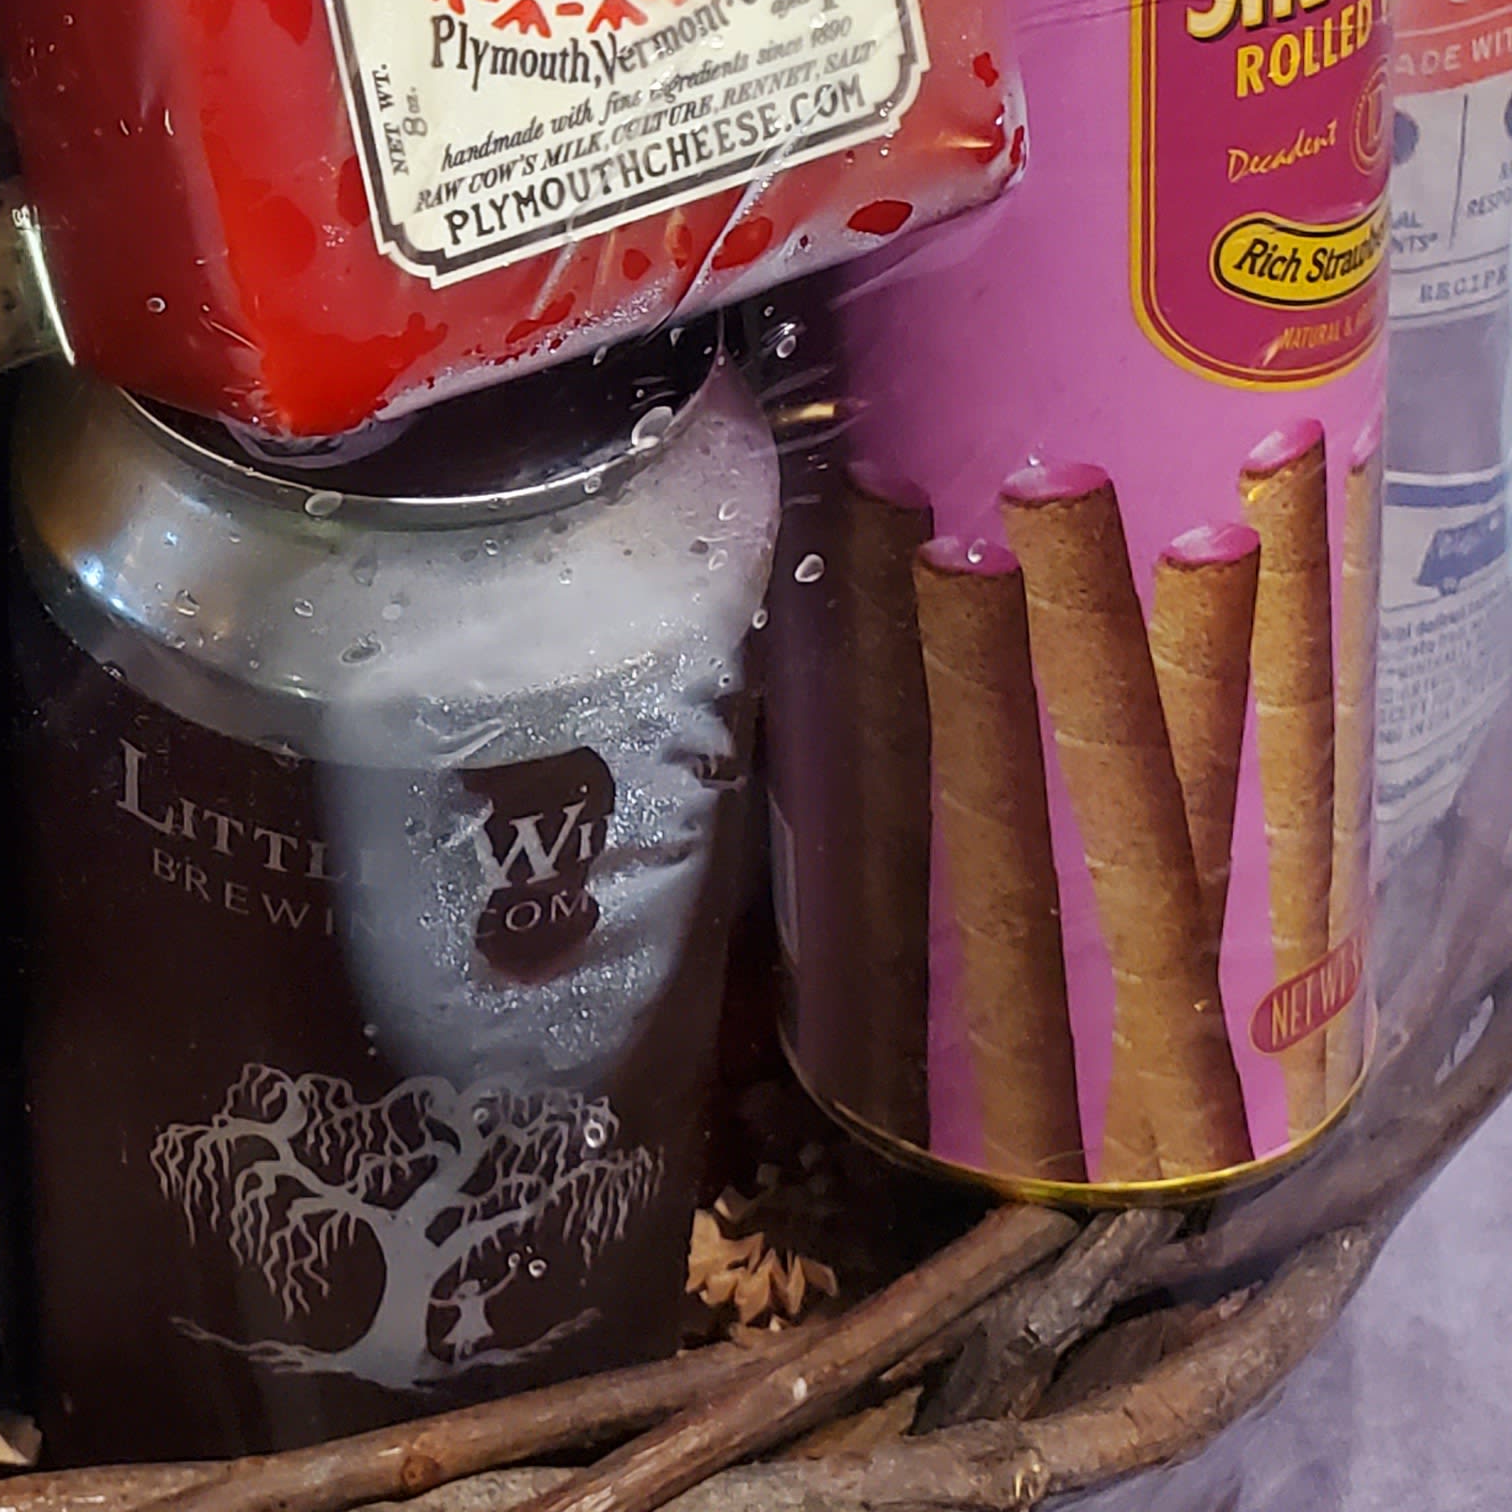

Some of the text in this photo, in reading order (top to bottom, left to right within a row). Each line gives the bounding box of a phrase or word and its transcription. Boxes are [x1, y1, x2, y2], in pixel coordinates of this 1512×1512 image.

[372, 64, 409, 177] NET WT.
[441, 116, 544, 171] handmade
[550, 98, 594, 135] with
[598, 89, 641, 126] fine
[445, 73, 866, 245] PLYMOUTHCHEESE.COM
[1228, 119, 1337, 183] Decadent
[414, 176, 465, 213] RAW
[469, 153, 538, 194] COW'S
[541, 131, 608, 170] MILK,
[1234, 238, 1302, 283] Rich
